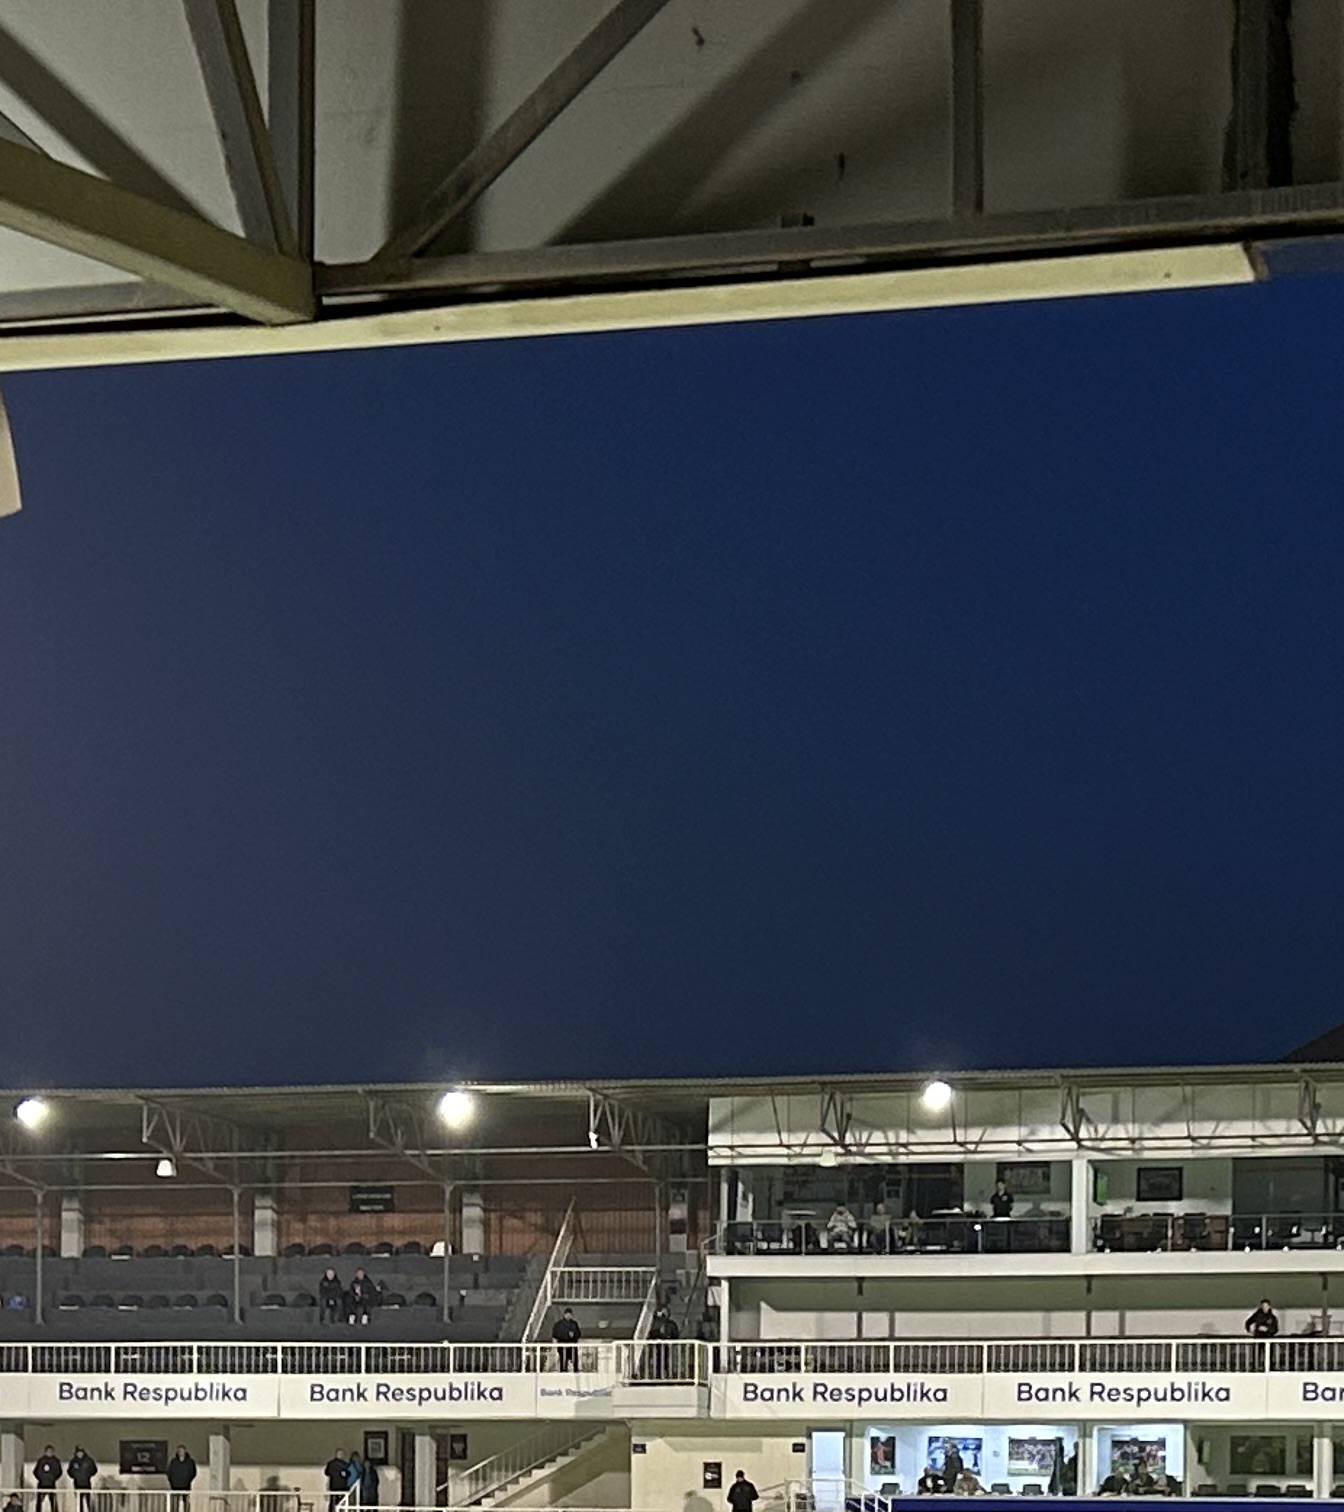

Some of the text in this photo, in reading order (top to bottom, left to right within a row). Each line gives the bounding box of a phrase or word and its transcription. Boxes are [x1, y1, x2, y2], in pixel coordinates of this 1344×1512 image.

[59, 1382, 247, 1406] Bank Respublika
[311, 1382, 503, 1406] Bank Respublika
[743, 1382, 948, 1407] Bank Respublika
[1018, 1382, 1230, 1407] Bank Respublika
